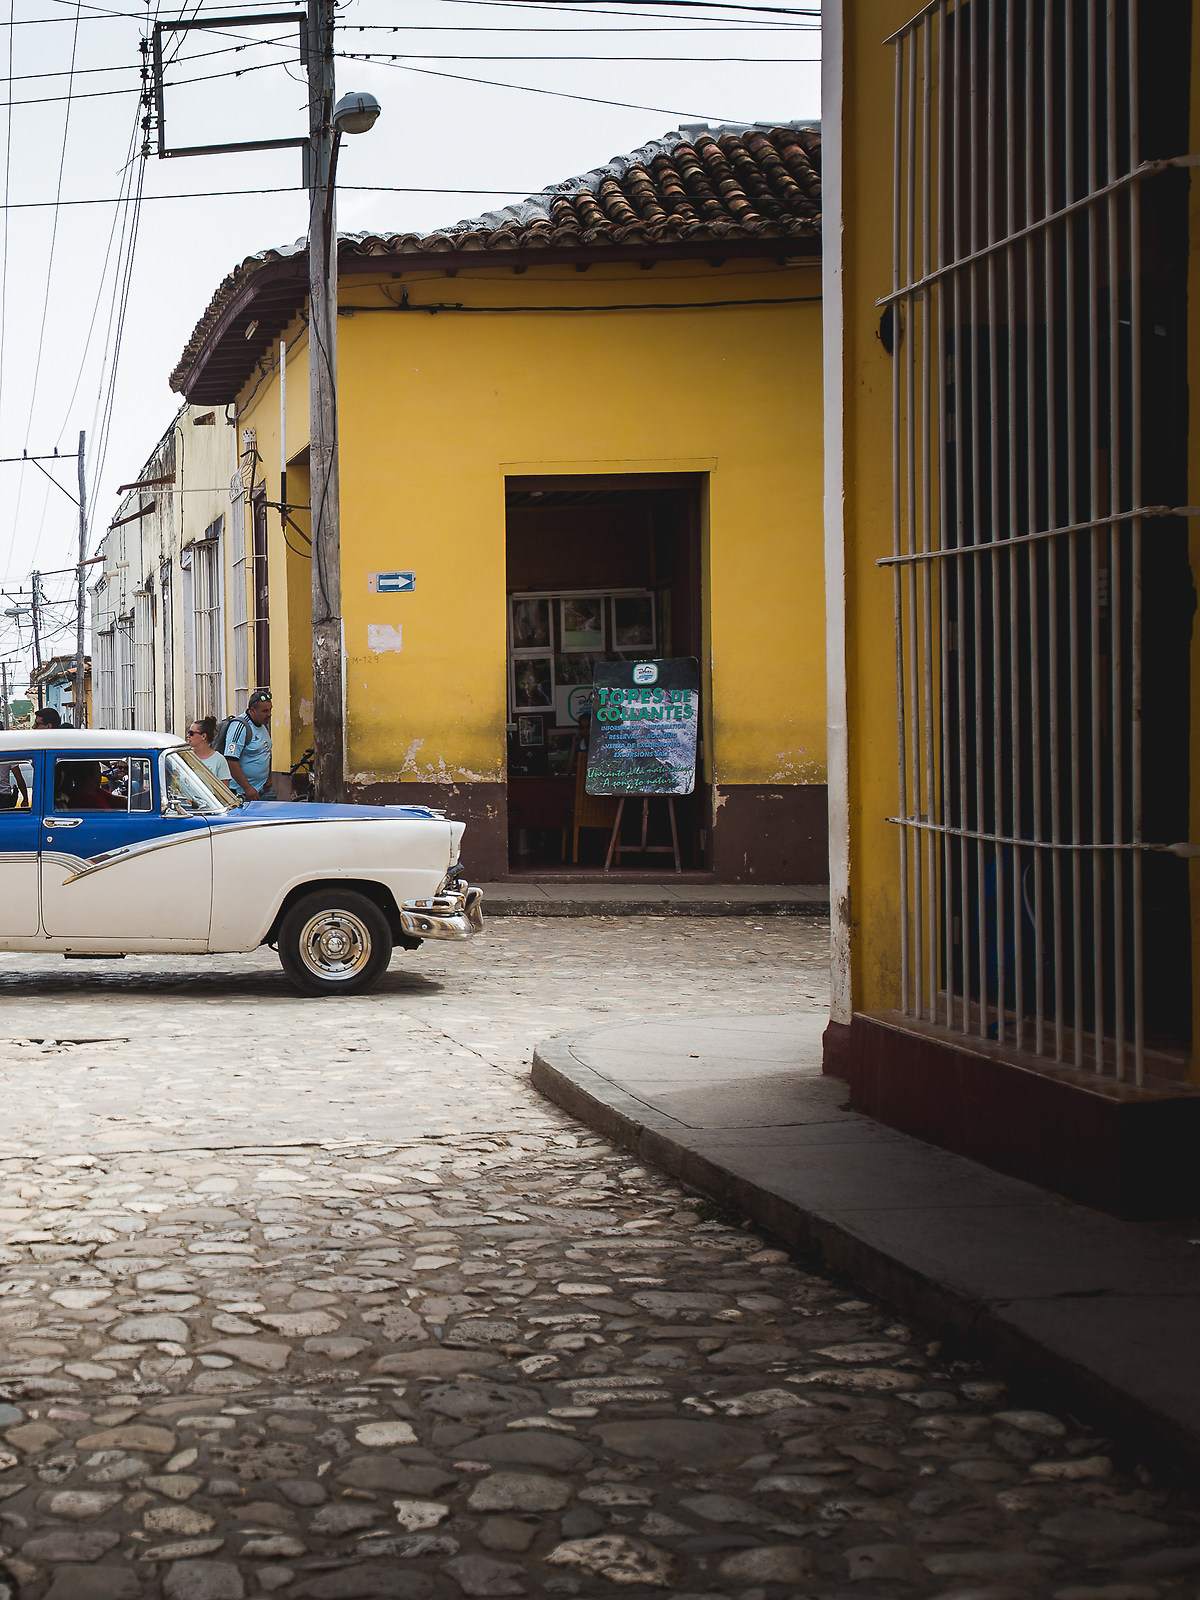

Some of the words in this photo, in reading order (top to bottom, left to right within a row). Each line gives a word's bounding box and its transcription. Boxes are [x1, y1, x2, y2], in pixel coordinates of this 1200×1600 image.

[598, 688, 663, 705] TOPES
[671, 689, 692, 702] DE
[597, 705, 693, 721] COLLANTES
[602, 778, 610, 788] A
